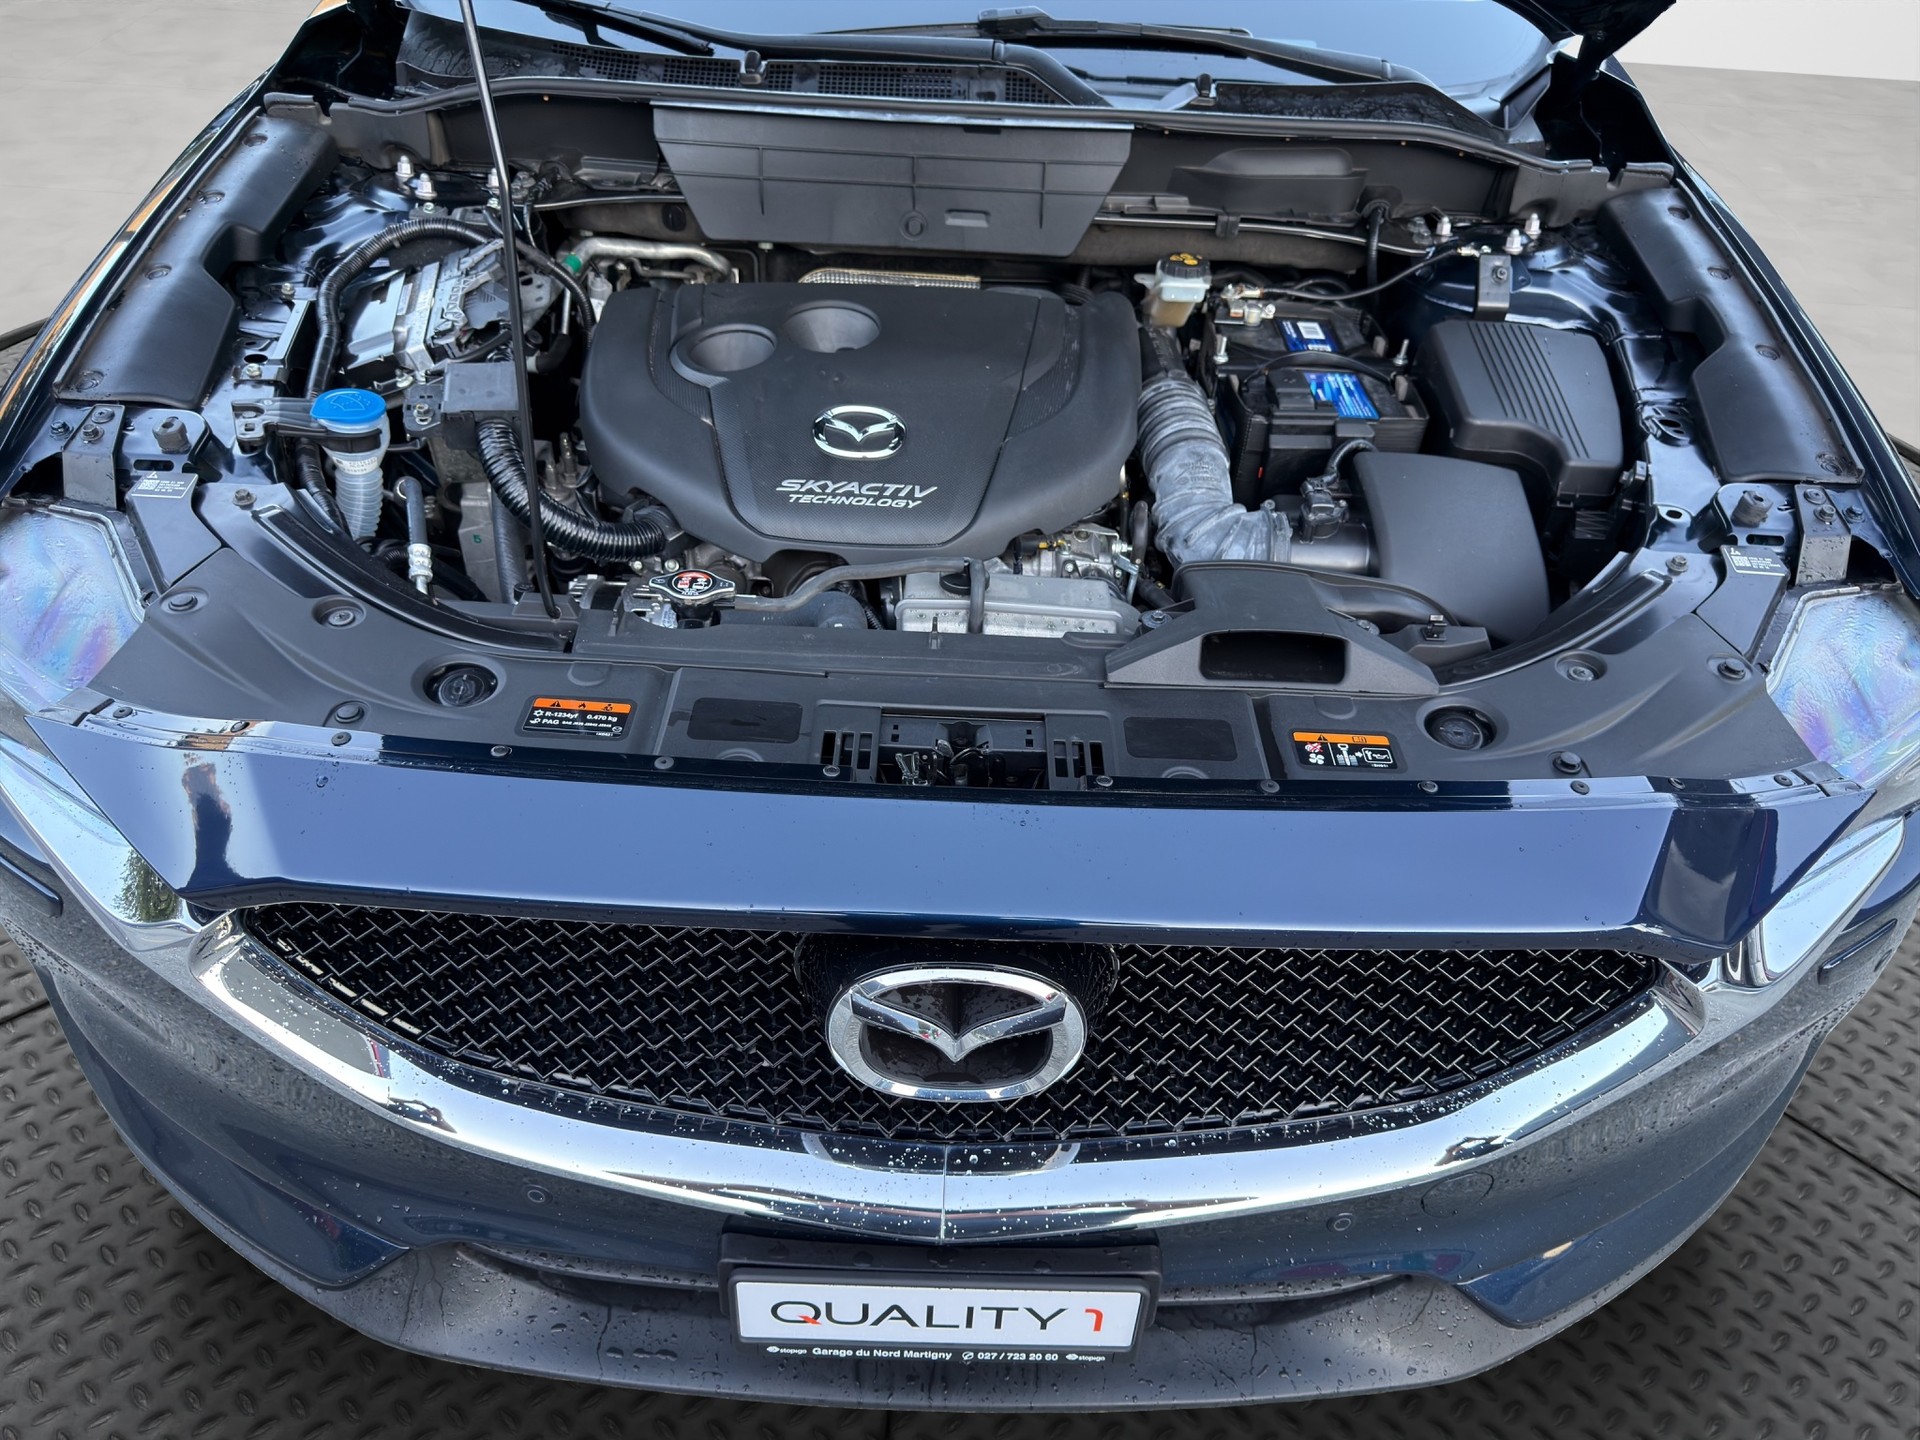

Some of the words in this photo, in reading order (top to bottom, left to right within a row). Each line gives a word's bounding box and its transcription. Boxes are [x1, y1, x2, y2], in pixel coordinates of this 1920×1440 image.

[776, 479, 938, 498] SKYACTIV
[788, 494, 923, 509] TECHNOLOGY
[544, 711, 579, 719] R-1234yf
[586, 713, 606, 721] 0.470
[607, 714, 618, 723] kg
[770, 1300, 1068, 1331] QUALITY
[1084, 1307, 1105, 1332] 1
[812, 1347, 853, 1358] Garage
[855, 1348, 870, 1357] du
[873, 1349, 900, 1358] Nord
[903, 1349, 953, 1361] Martigny
[977, 1351, 998, 1360] 027
[1007, 1352, 1027, 1361] 723
[1028, 1352, 1043, 1361] 20
[1044, 1353, 1059, 1361] 60
